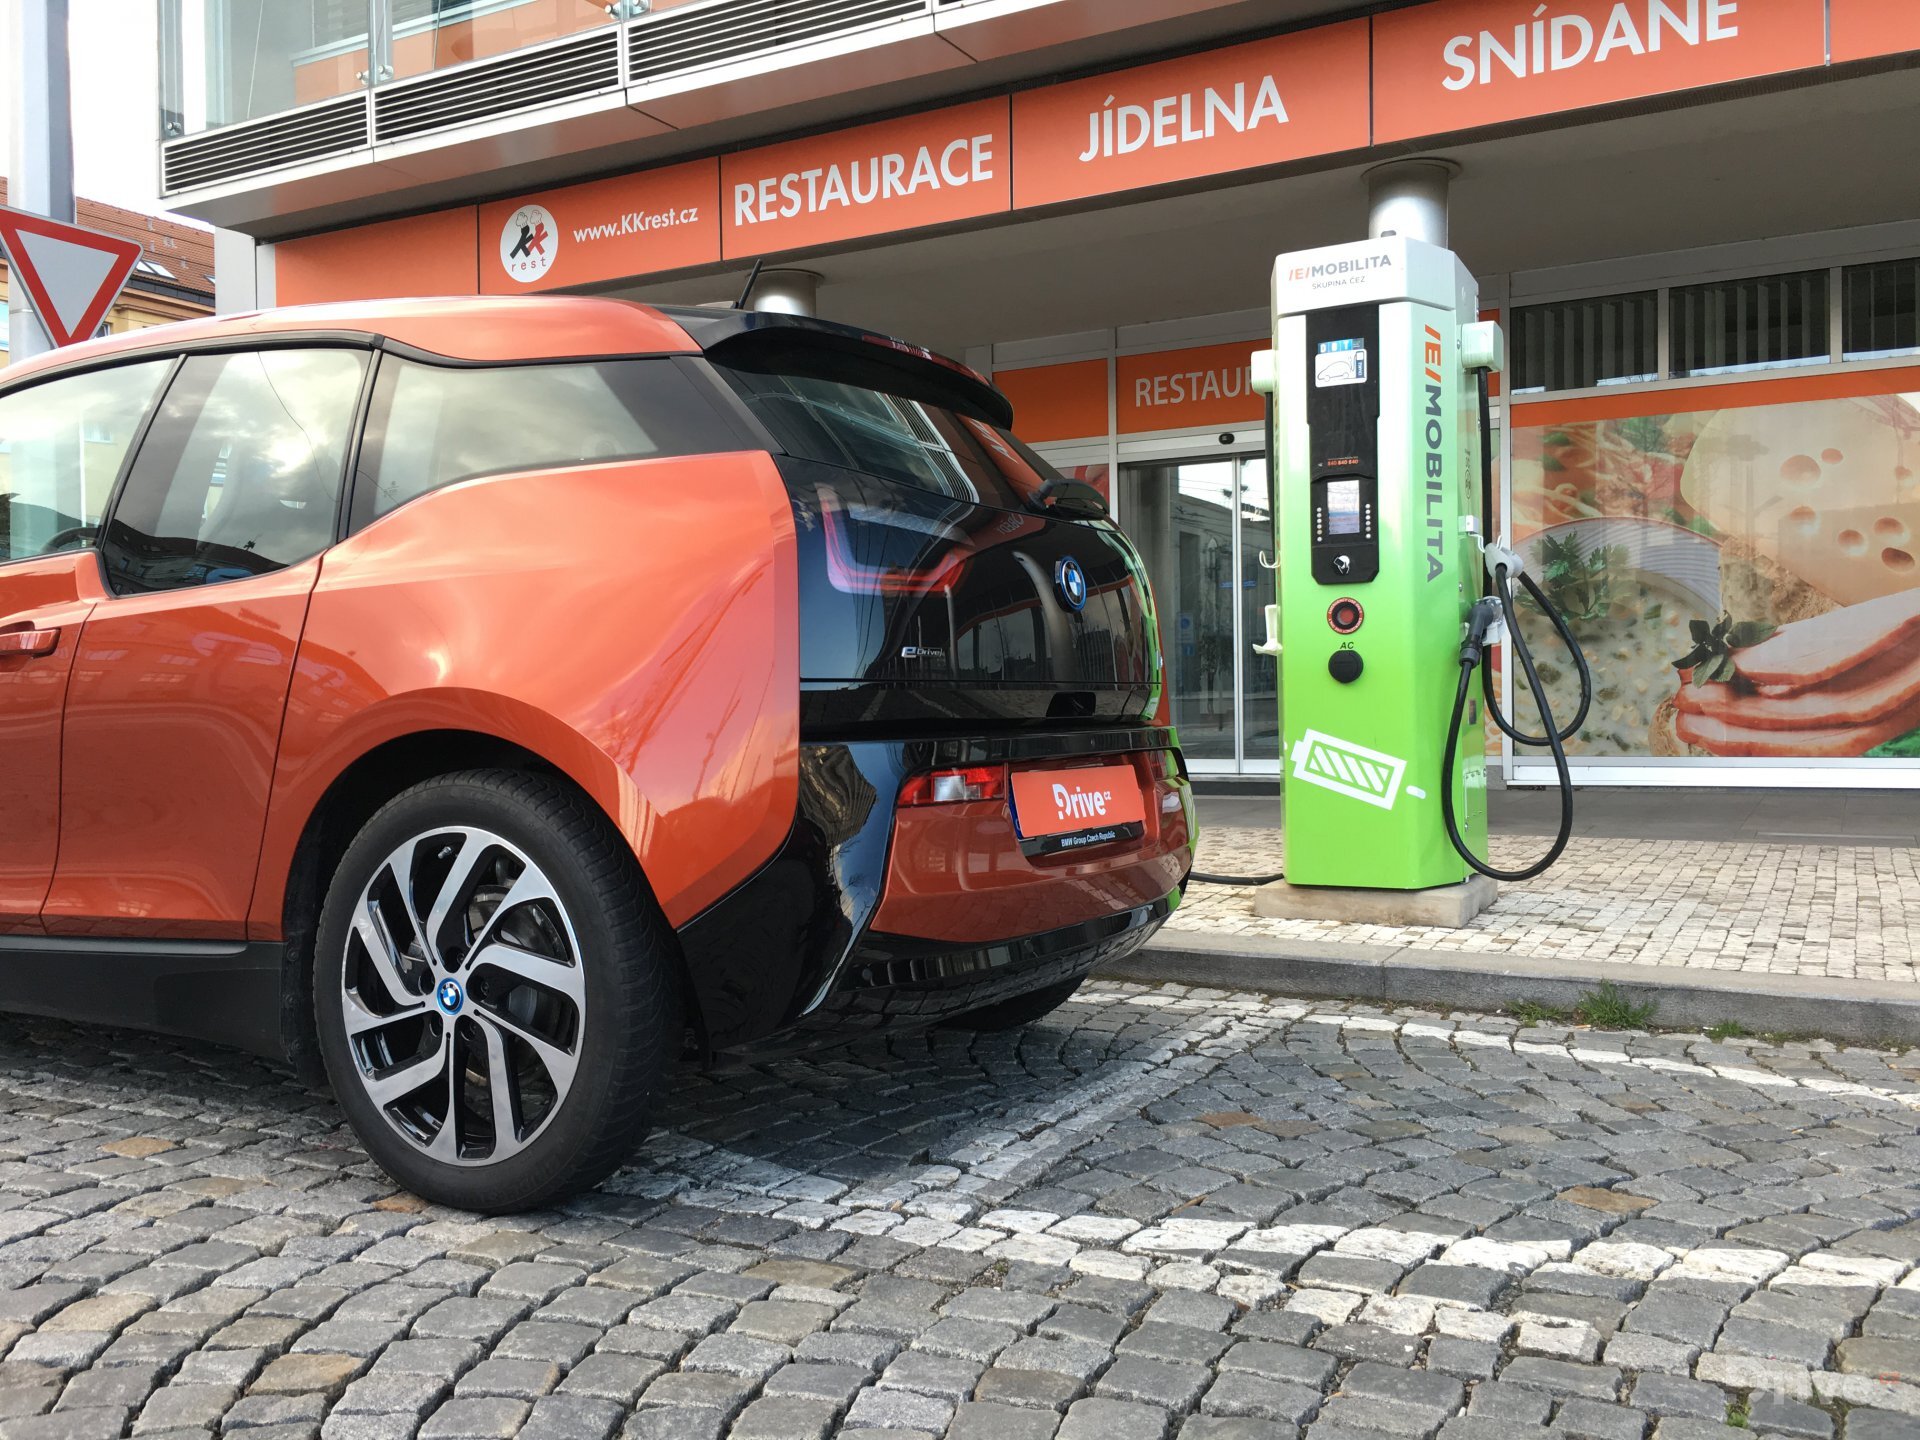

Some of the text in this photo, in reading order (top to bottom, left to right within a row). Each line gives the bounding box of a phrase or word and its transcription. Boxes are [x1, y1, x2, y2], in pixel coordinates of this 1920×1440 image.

[1078, 75, 1289, 164] JÍDELNA
[734, 133, 994, 227] RESTAURACE
[572, 207, 699, 244] www.KKrest.cz
[511, 256, 547, 273] rest
[1311, 279, 1348, 290] SKUPINA
[1339, 641, 1355, 650] AC
[1052, 783, 1107, 820] Drive
[1060, 830, 1116, 848] BMW Group Czech Republic
